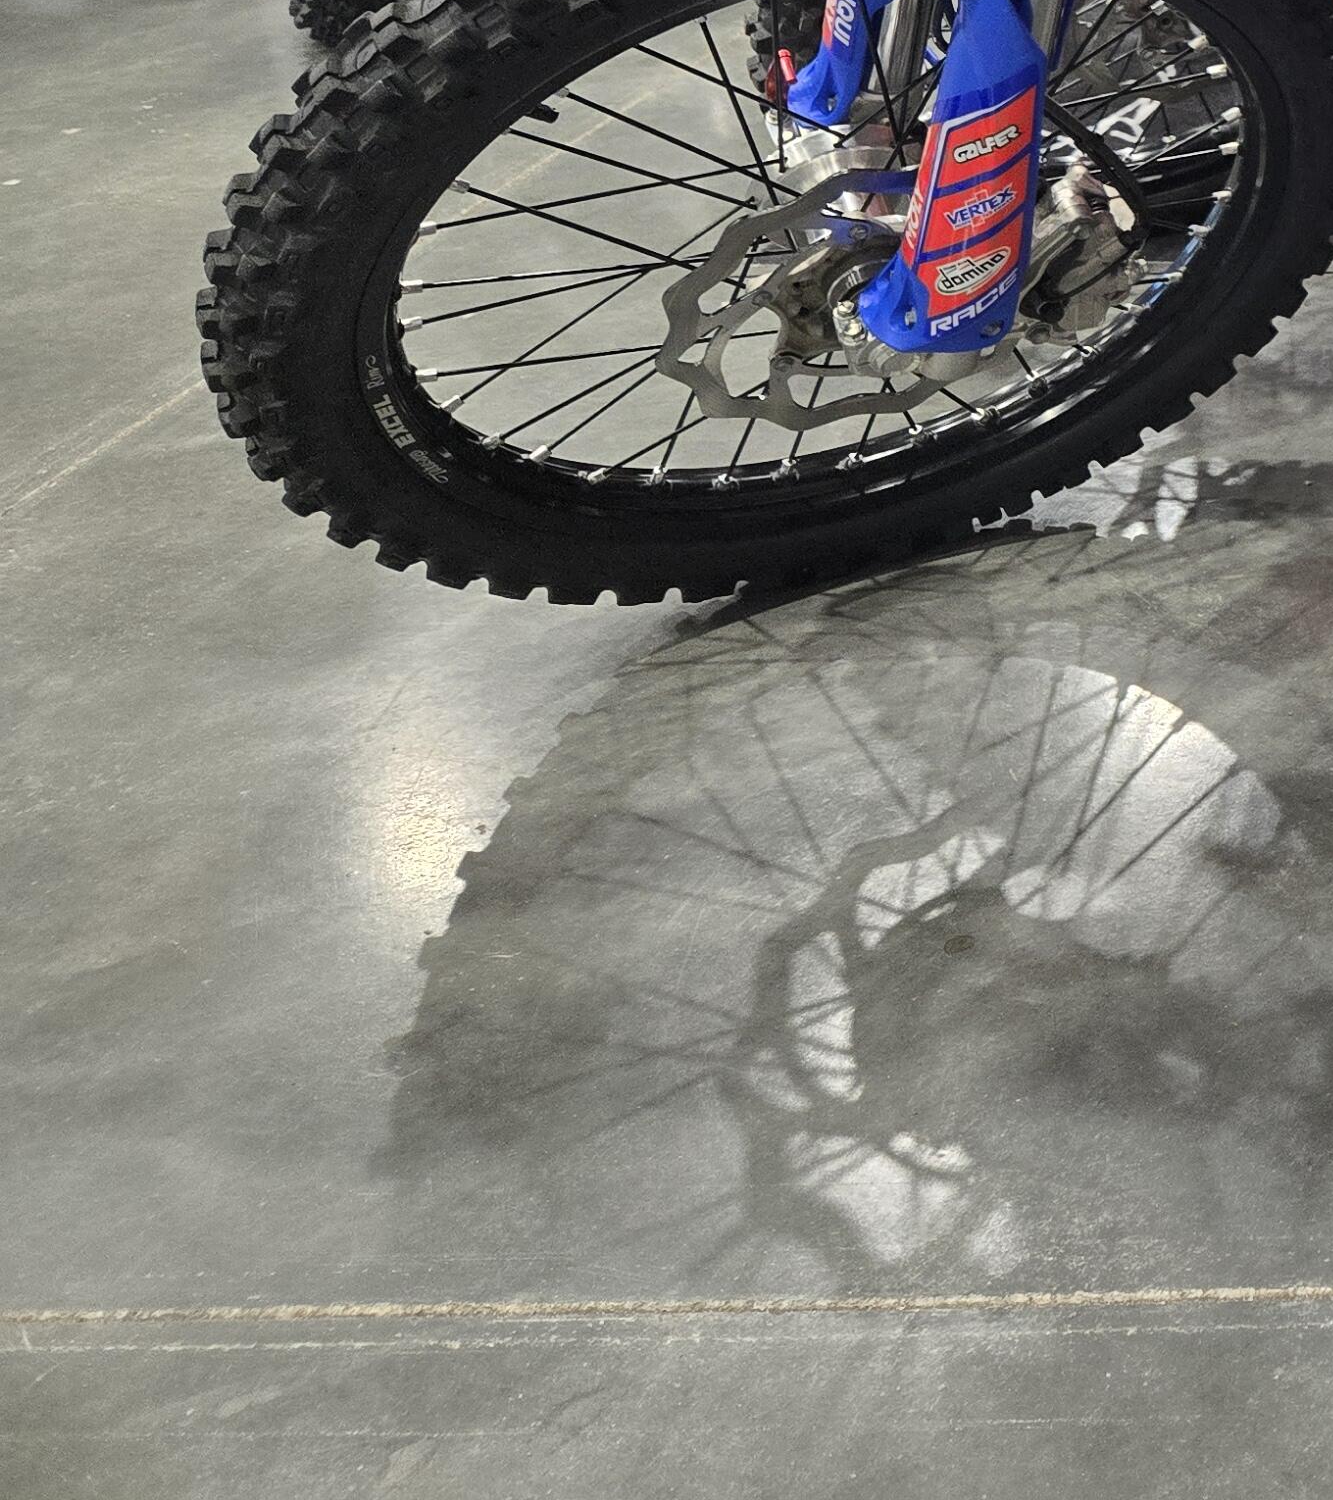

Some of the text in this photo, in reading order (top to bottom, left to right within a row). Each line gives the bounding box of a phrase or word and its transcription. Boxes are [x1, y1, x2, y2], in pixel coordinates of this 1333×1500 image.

[953, 124, 1021, 164] GALFER
[946, 186, 1015, 228] VERTEX
[940, 252, 1005, 291] domino
[929, 267, 1019, 337] RACE
[372, 393, 417, 450] EXCEL
